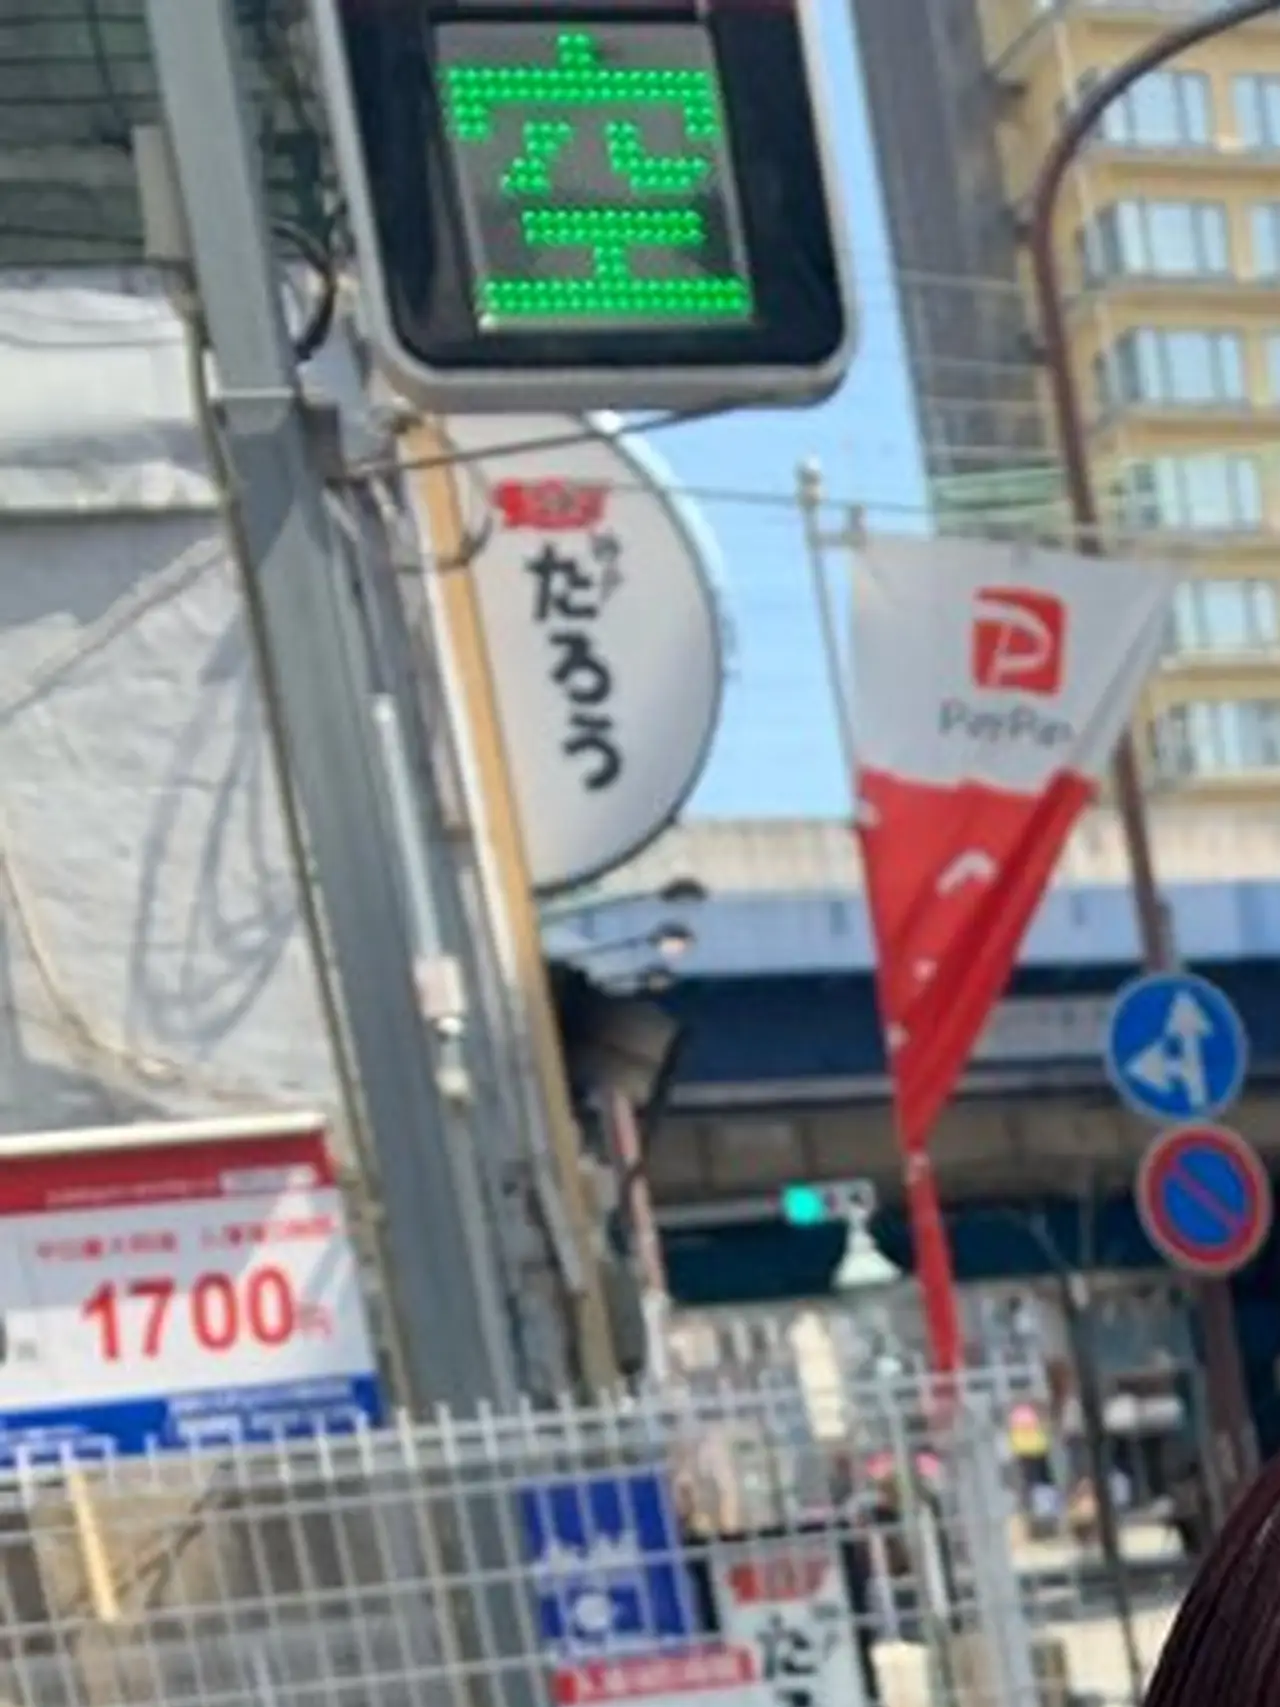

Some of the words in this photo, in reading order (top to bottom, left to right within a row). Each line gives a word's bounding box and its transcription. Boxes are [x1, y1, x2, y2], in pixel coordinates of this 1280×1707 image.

[444, 30, 750, 314] 空
[524, 542, 622, 791] たろう
[83, 1264, 297, 1363] 1700
